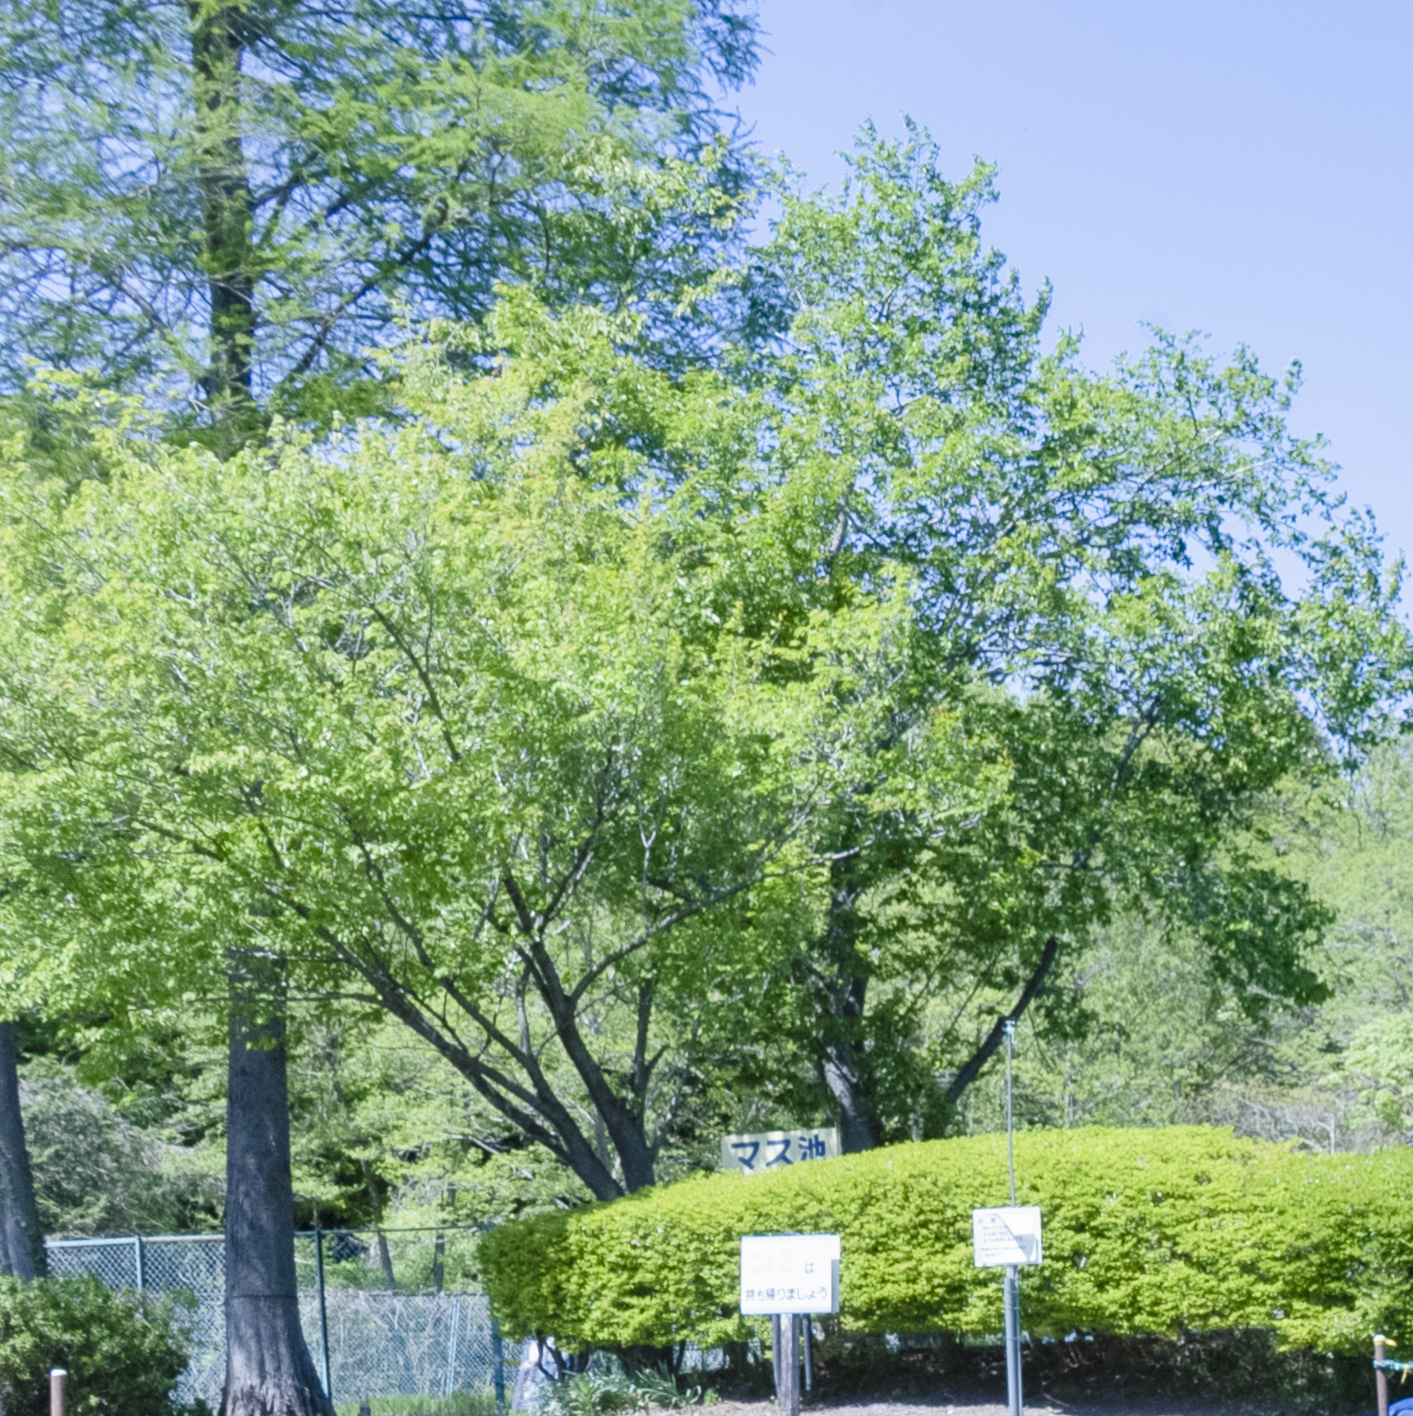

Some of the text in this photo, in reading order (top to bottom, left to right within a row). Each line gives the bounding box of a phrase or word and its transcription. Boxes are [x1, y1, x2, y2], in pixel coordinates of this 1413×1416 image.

[730, 1134, 826, 1169] マス池
[745, 1286, 828, 1302] 持ち帰りましょう
